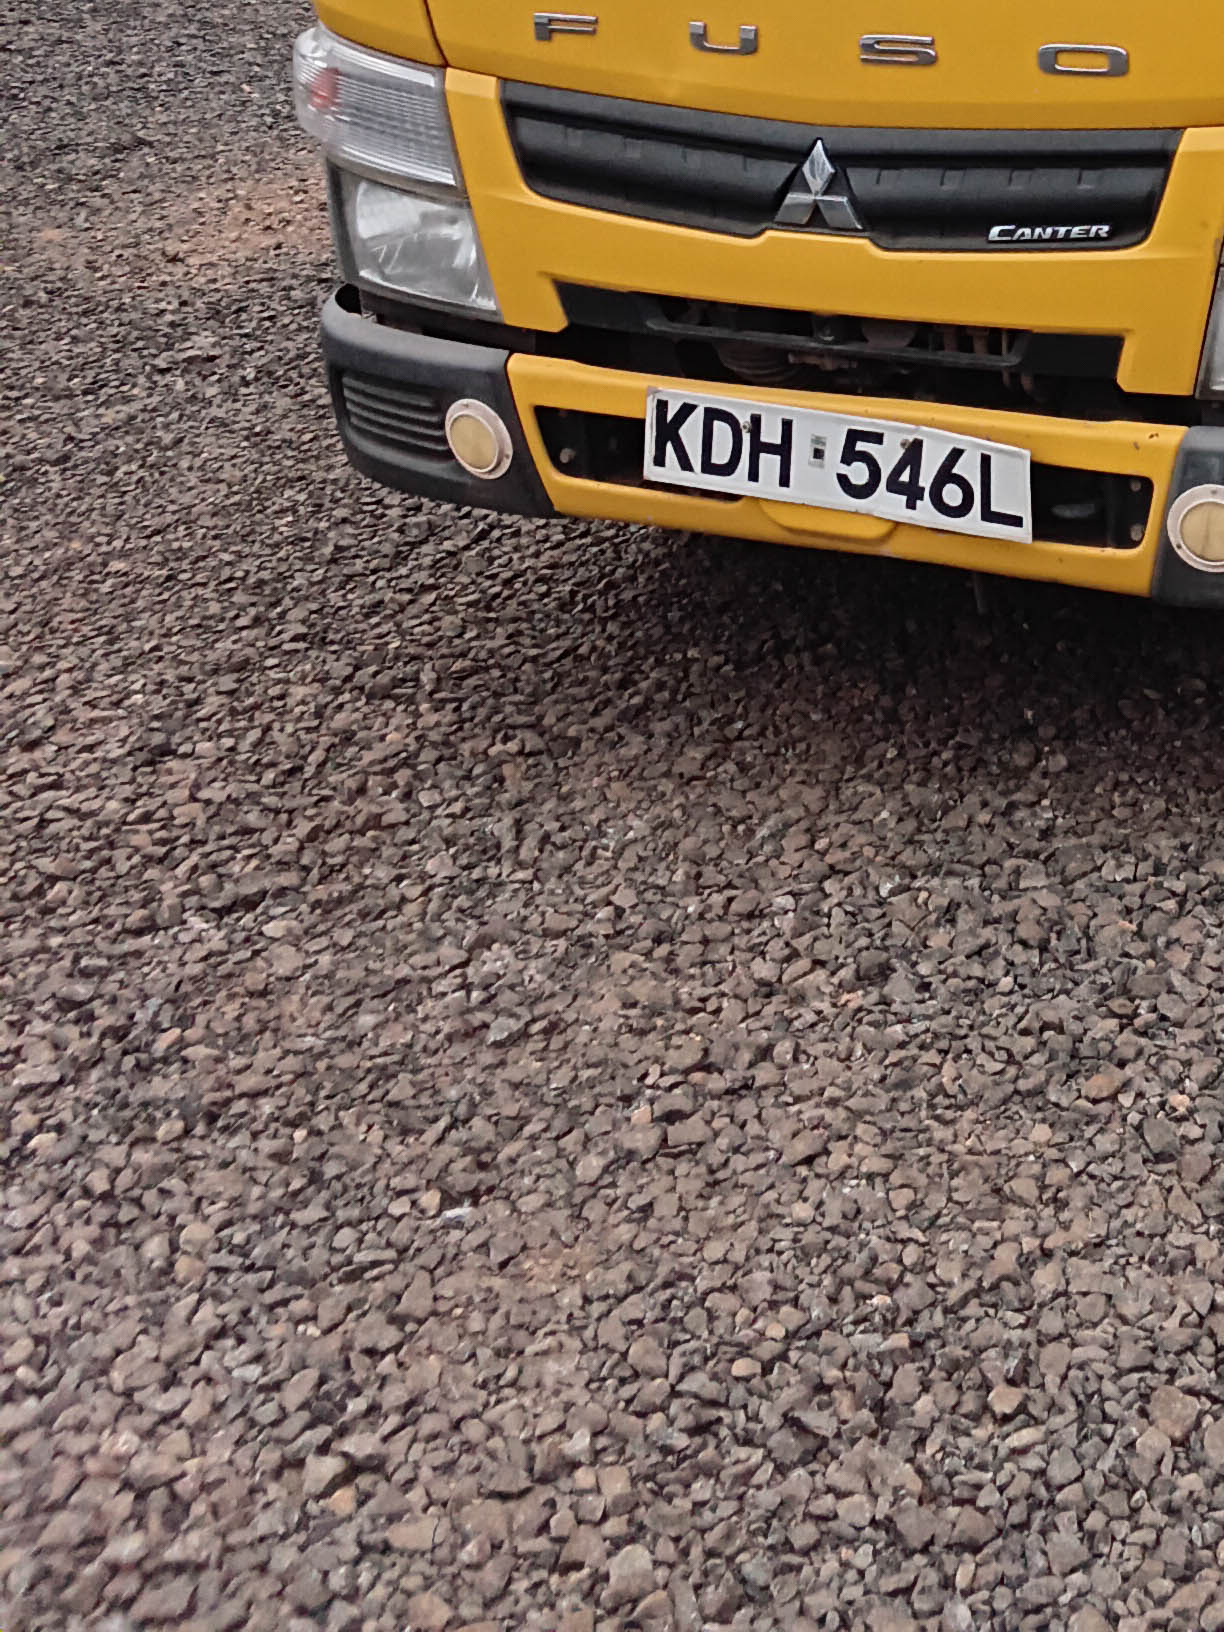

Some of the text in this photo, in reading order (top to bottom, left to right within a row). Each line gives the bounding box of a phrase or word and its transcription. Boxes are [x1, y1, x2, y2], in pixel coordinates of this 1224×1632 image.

[532, 11, 1130, 78] FUSO
[988, 223, 1111, 243] CANTER
[653, 399, 1024, 529] KDH 546L
